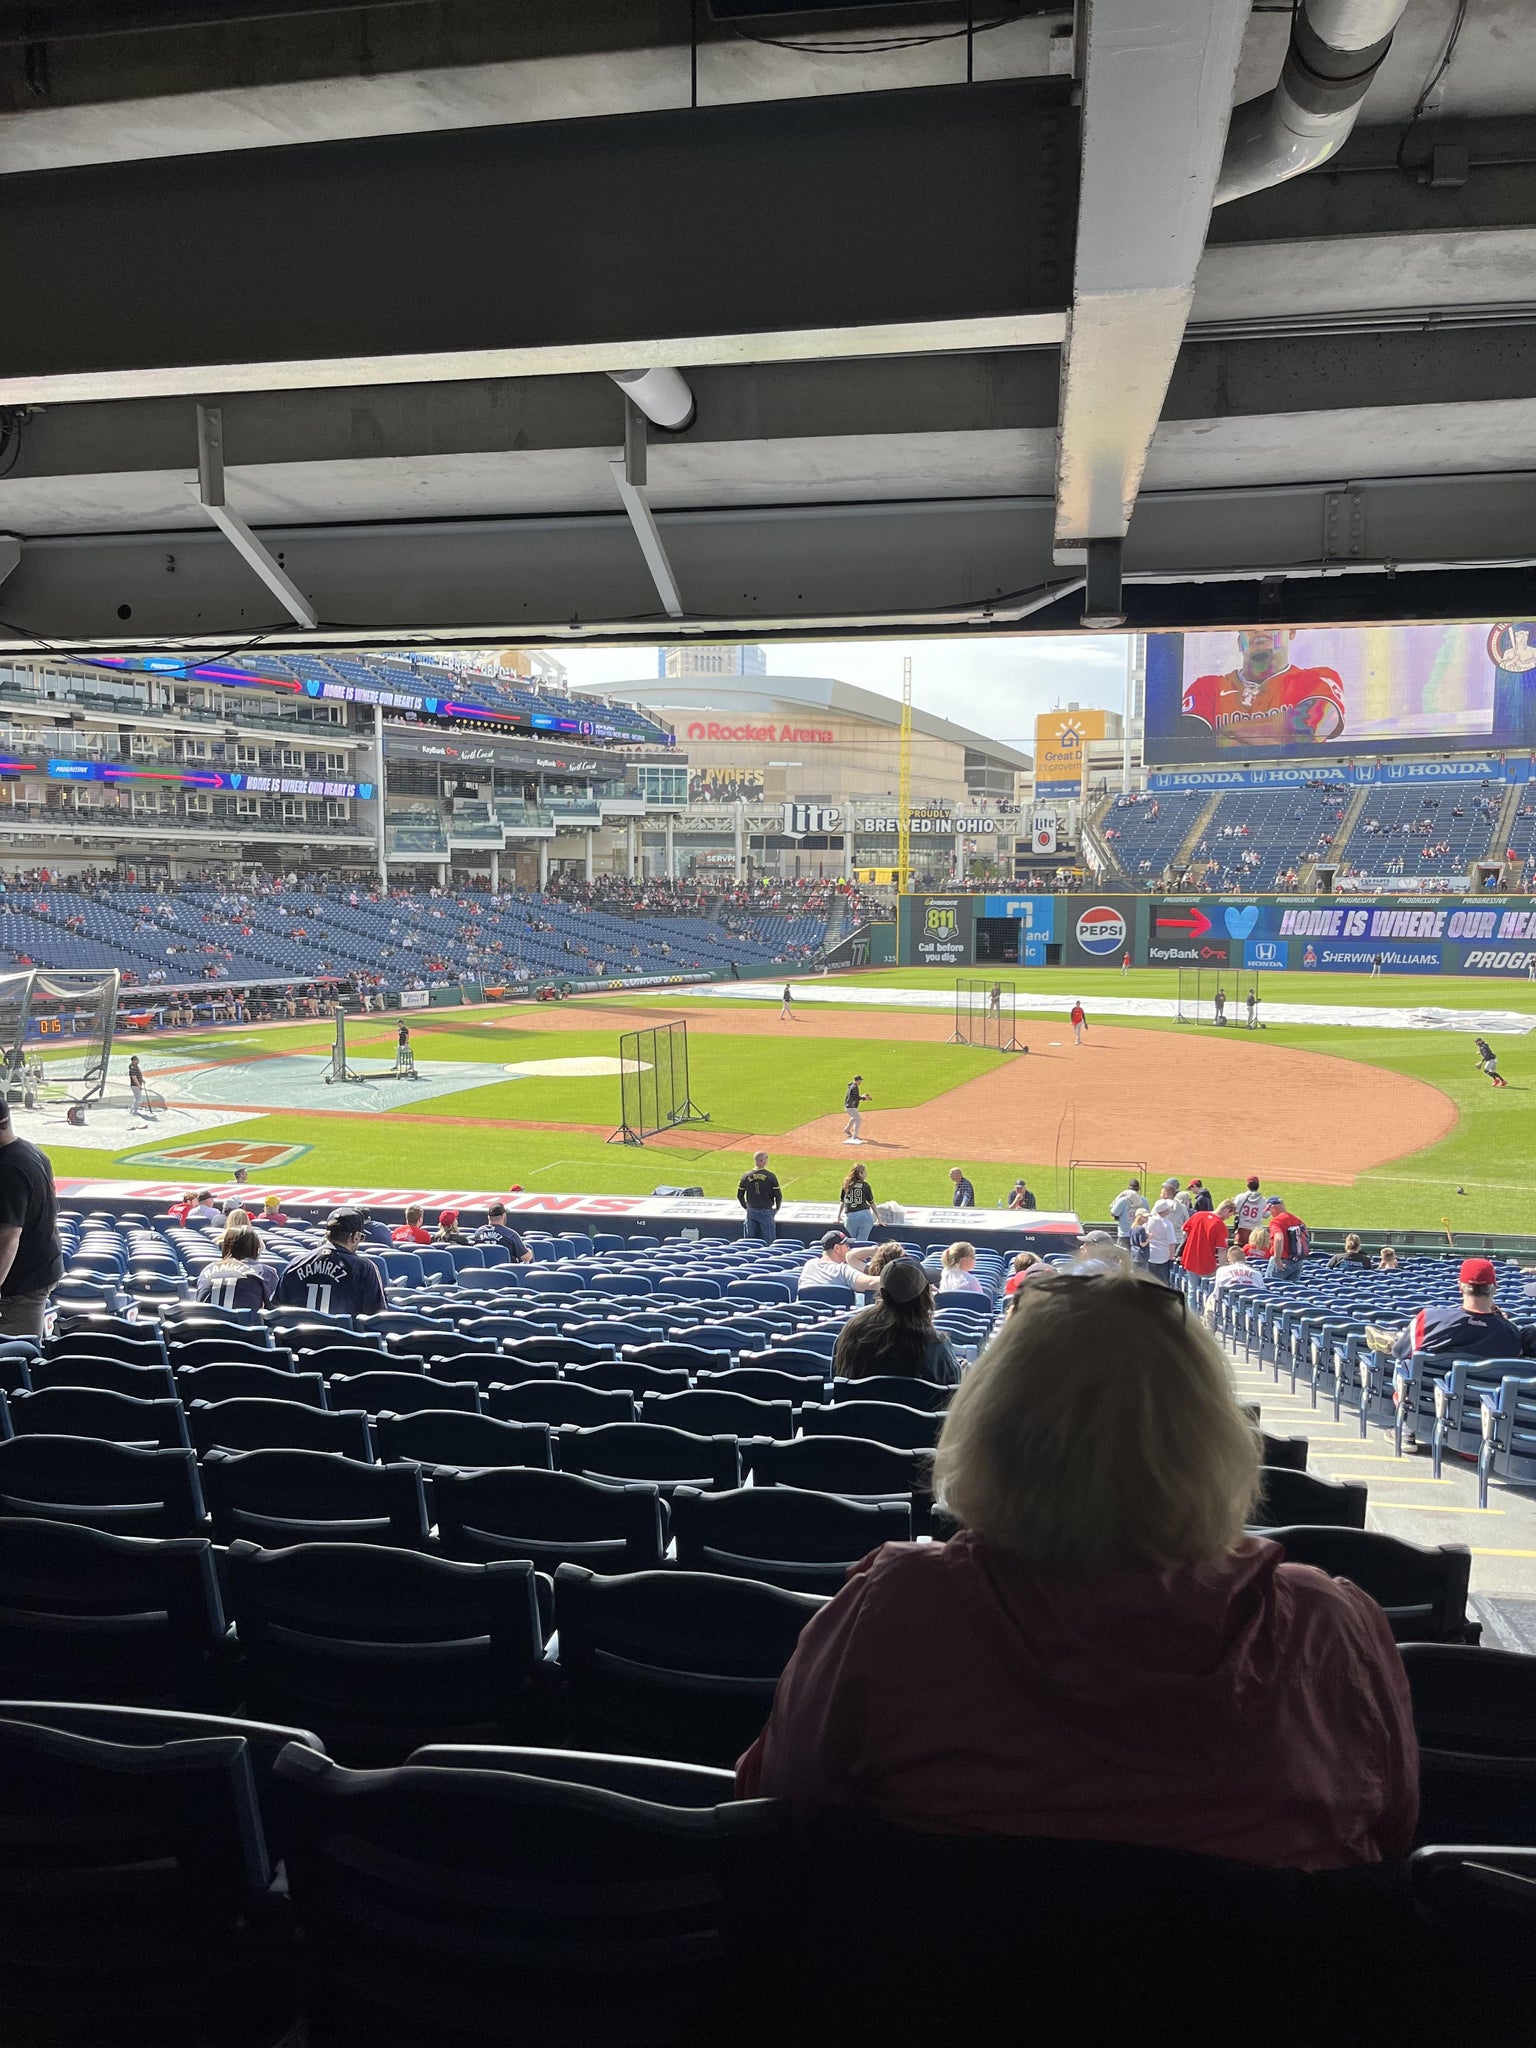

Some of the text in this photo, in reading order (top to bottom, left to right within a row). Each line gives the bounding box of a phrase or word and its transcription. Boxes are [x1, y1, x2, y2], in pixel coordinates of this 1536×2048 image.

[323, 683, 422, 710] HOME IS WHERE OUR HEART IS
[707, 723, 834, 744] Rocket Arena
[422, 745, 446, 756] KeyBank
[1045, 751, 1073, 761] Great
[1268, 766, 1347, 781] HONDA
[1408, 762, 1492, 776] HONDA
[688, 768, 764, 785] PLAYOFFS
[1174, 772, 1245, 785] HONDA
[247, 776, 355, 797] HOME IS WHERE OUR HEART IS
[780, 802, 842, 839] Lite
[909, 809, 951, 818] PROUDLY
[935, 818, 952, 833] IN
[955, 818, 995, 833] OHIO
[1035, 818, 1055, 831] Lite
[928, 909, 954, 928] 811
[1279, 910, 1344, 936] HOME
[1343, 910, 1368, 936] IS
[1370, 911, 1448, 937] WHERE
[1447, 911, 1497, 938] OUR
[1079, 926, 1123, 935] PEPSI
[918, 943, 964, 952] Call before
[1150, 948, 1199, 960] KeyBank
[883, 955, 896, 963] 325
[925, 953, 957, 963] you dig.
[124, 1183, 645, 1214] GUARDIANS
[1242, 1205, 1258, 1219] 36
[1229, 1269, 1254, 1279] THOME
[211, 1278, 238, 1309] 11
[306, 1283, 332, 1315] 11
